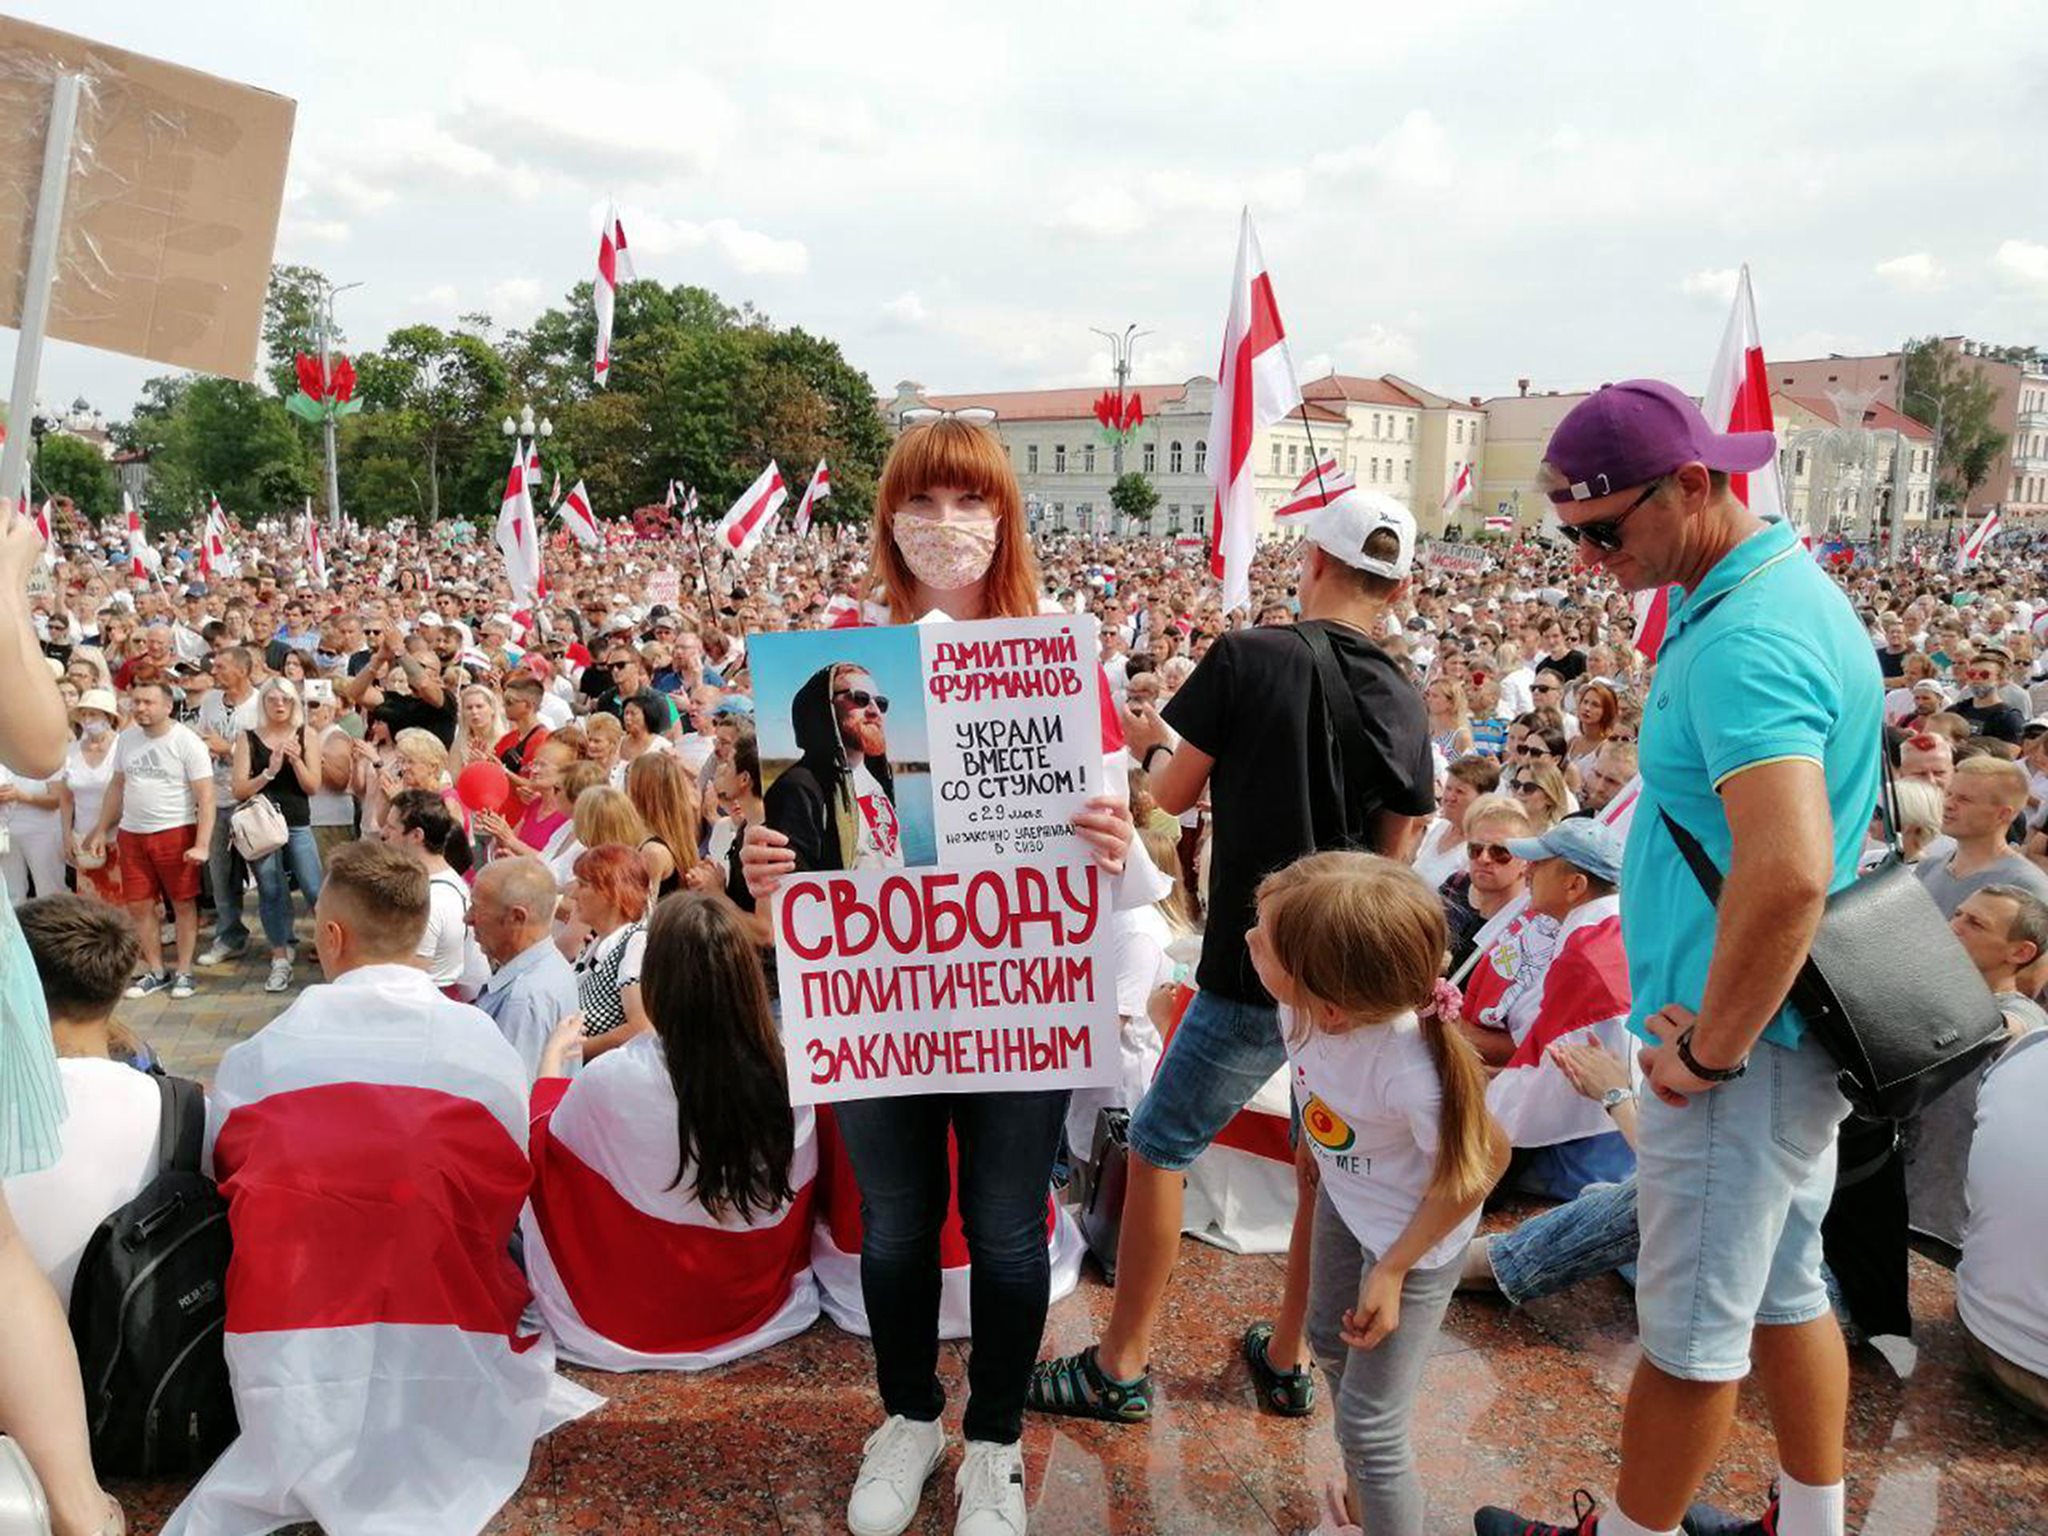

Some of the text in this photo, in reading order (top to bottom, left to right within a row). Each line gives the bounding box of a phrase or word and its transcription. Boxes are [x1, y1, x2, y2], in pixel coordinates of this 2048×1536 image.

[932, 627, 1078, 672] ДМИТРИЙ
[929, 667, 1082, 703] ФУРМАНОВ
[956, 715, 1063, 749] УКРАЛИ
[963, 746, 1051, 776] ВМЕСТЕ
[941, 780, 970, 801] СО
[982, 804, 1005, 821] 29
[1008, 809, 1044, 820] мая
[1015, 840, 1044, 853] СИЗО
[782, 865, 1099, 961] СВОБОДУ
[802, 956, 1095, 1018] ПОЛИТИЧЕСКИМ
[806, 1025, 1092, 1085] ЗАКЛЮЧЕННЫМ
